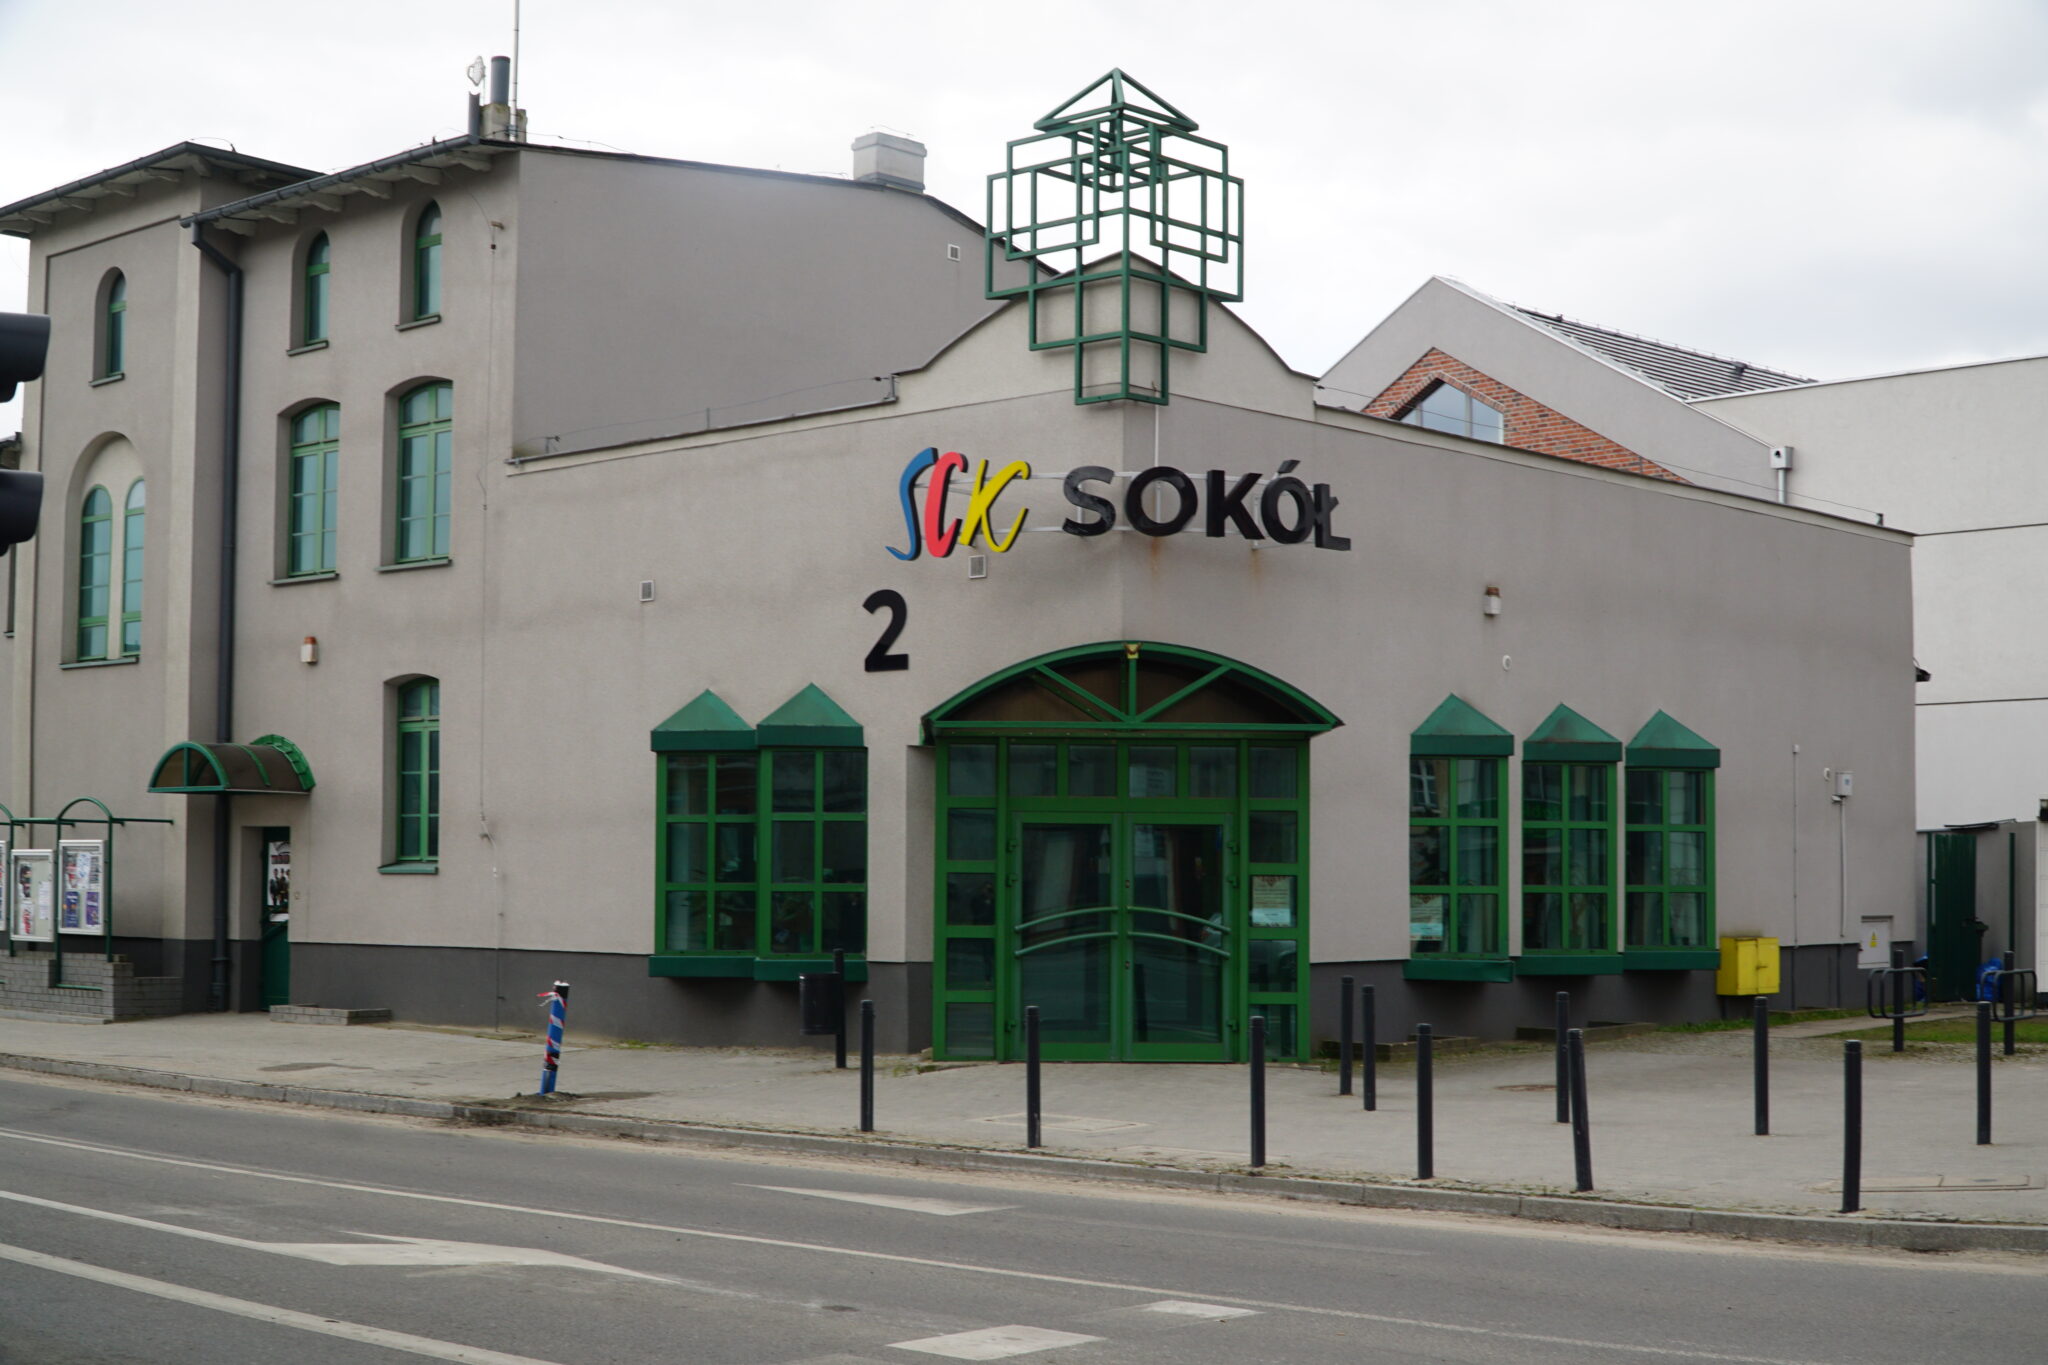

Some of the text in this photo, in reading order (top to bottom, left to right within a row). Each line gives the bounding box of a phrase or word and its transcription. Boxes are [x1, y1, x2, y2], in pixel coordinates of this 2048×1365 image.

[885, 447, 1351, 560] SCK SOKÓŁ
[863, 589, 909, 672] 2
